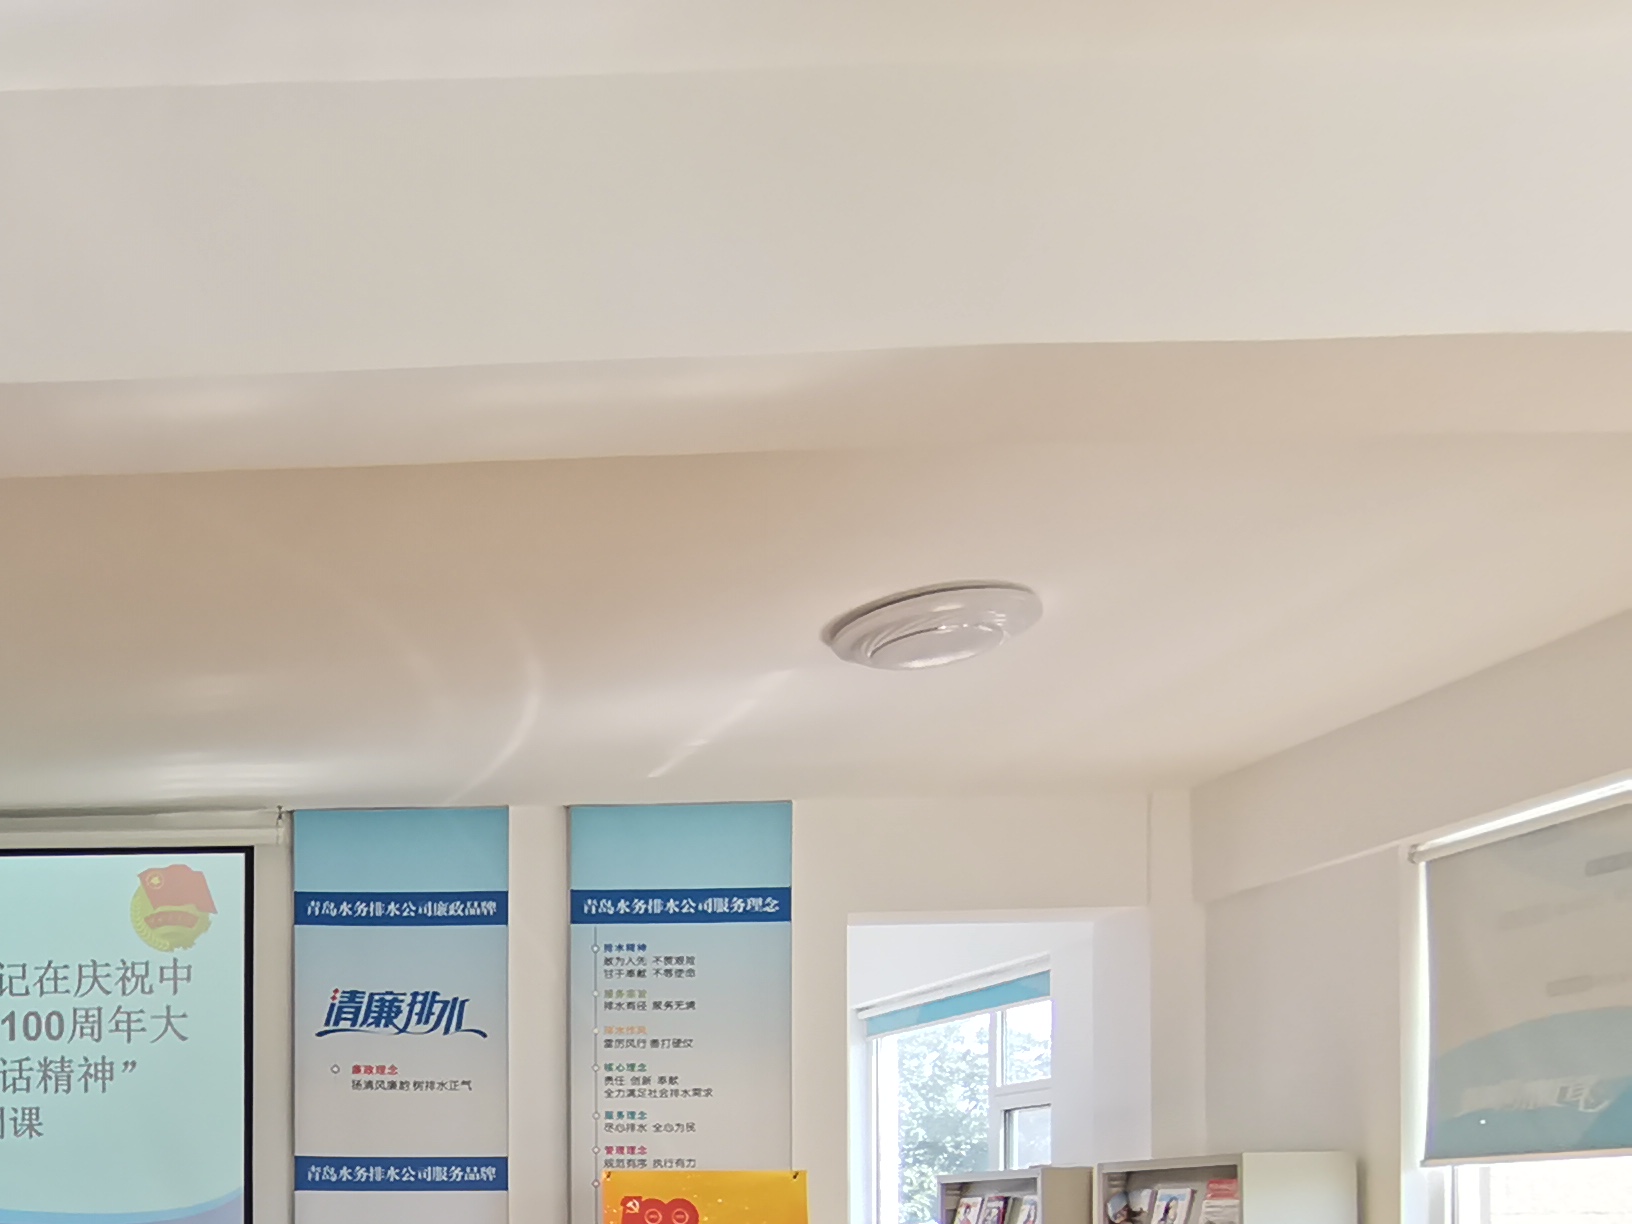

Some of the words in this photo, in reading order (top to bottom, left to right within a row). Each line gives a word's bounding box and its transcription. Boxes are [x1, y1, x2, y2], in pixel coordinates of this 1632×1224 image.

[306, 900, 497, 917] 青岛水务排水公司廉政品牌
[583, 897, 780, 915] 青岛水务排水公司服务理念
[318, 988, 480, 1037] 清廉排水
[307, 1164, 497, 1183] 青岛水务排水公司服务品牌
